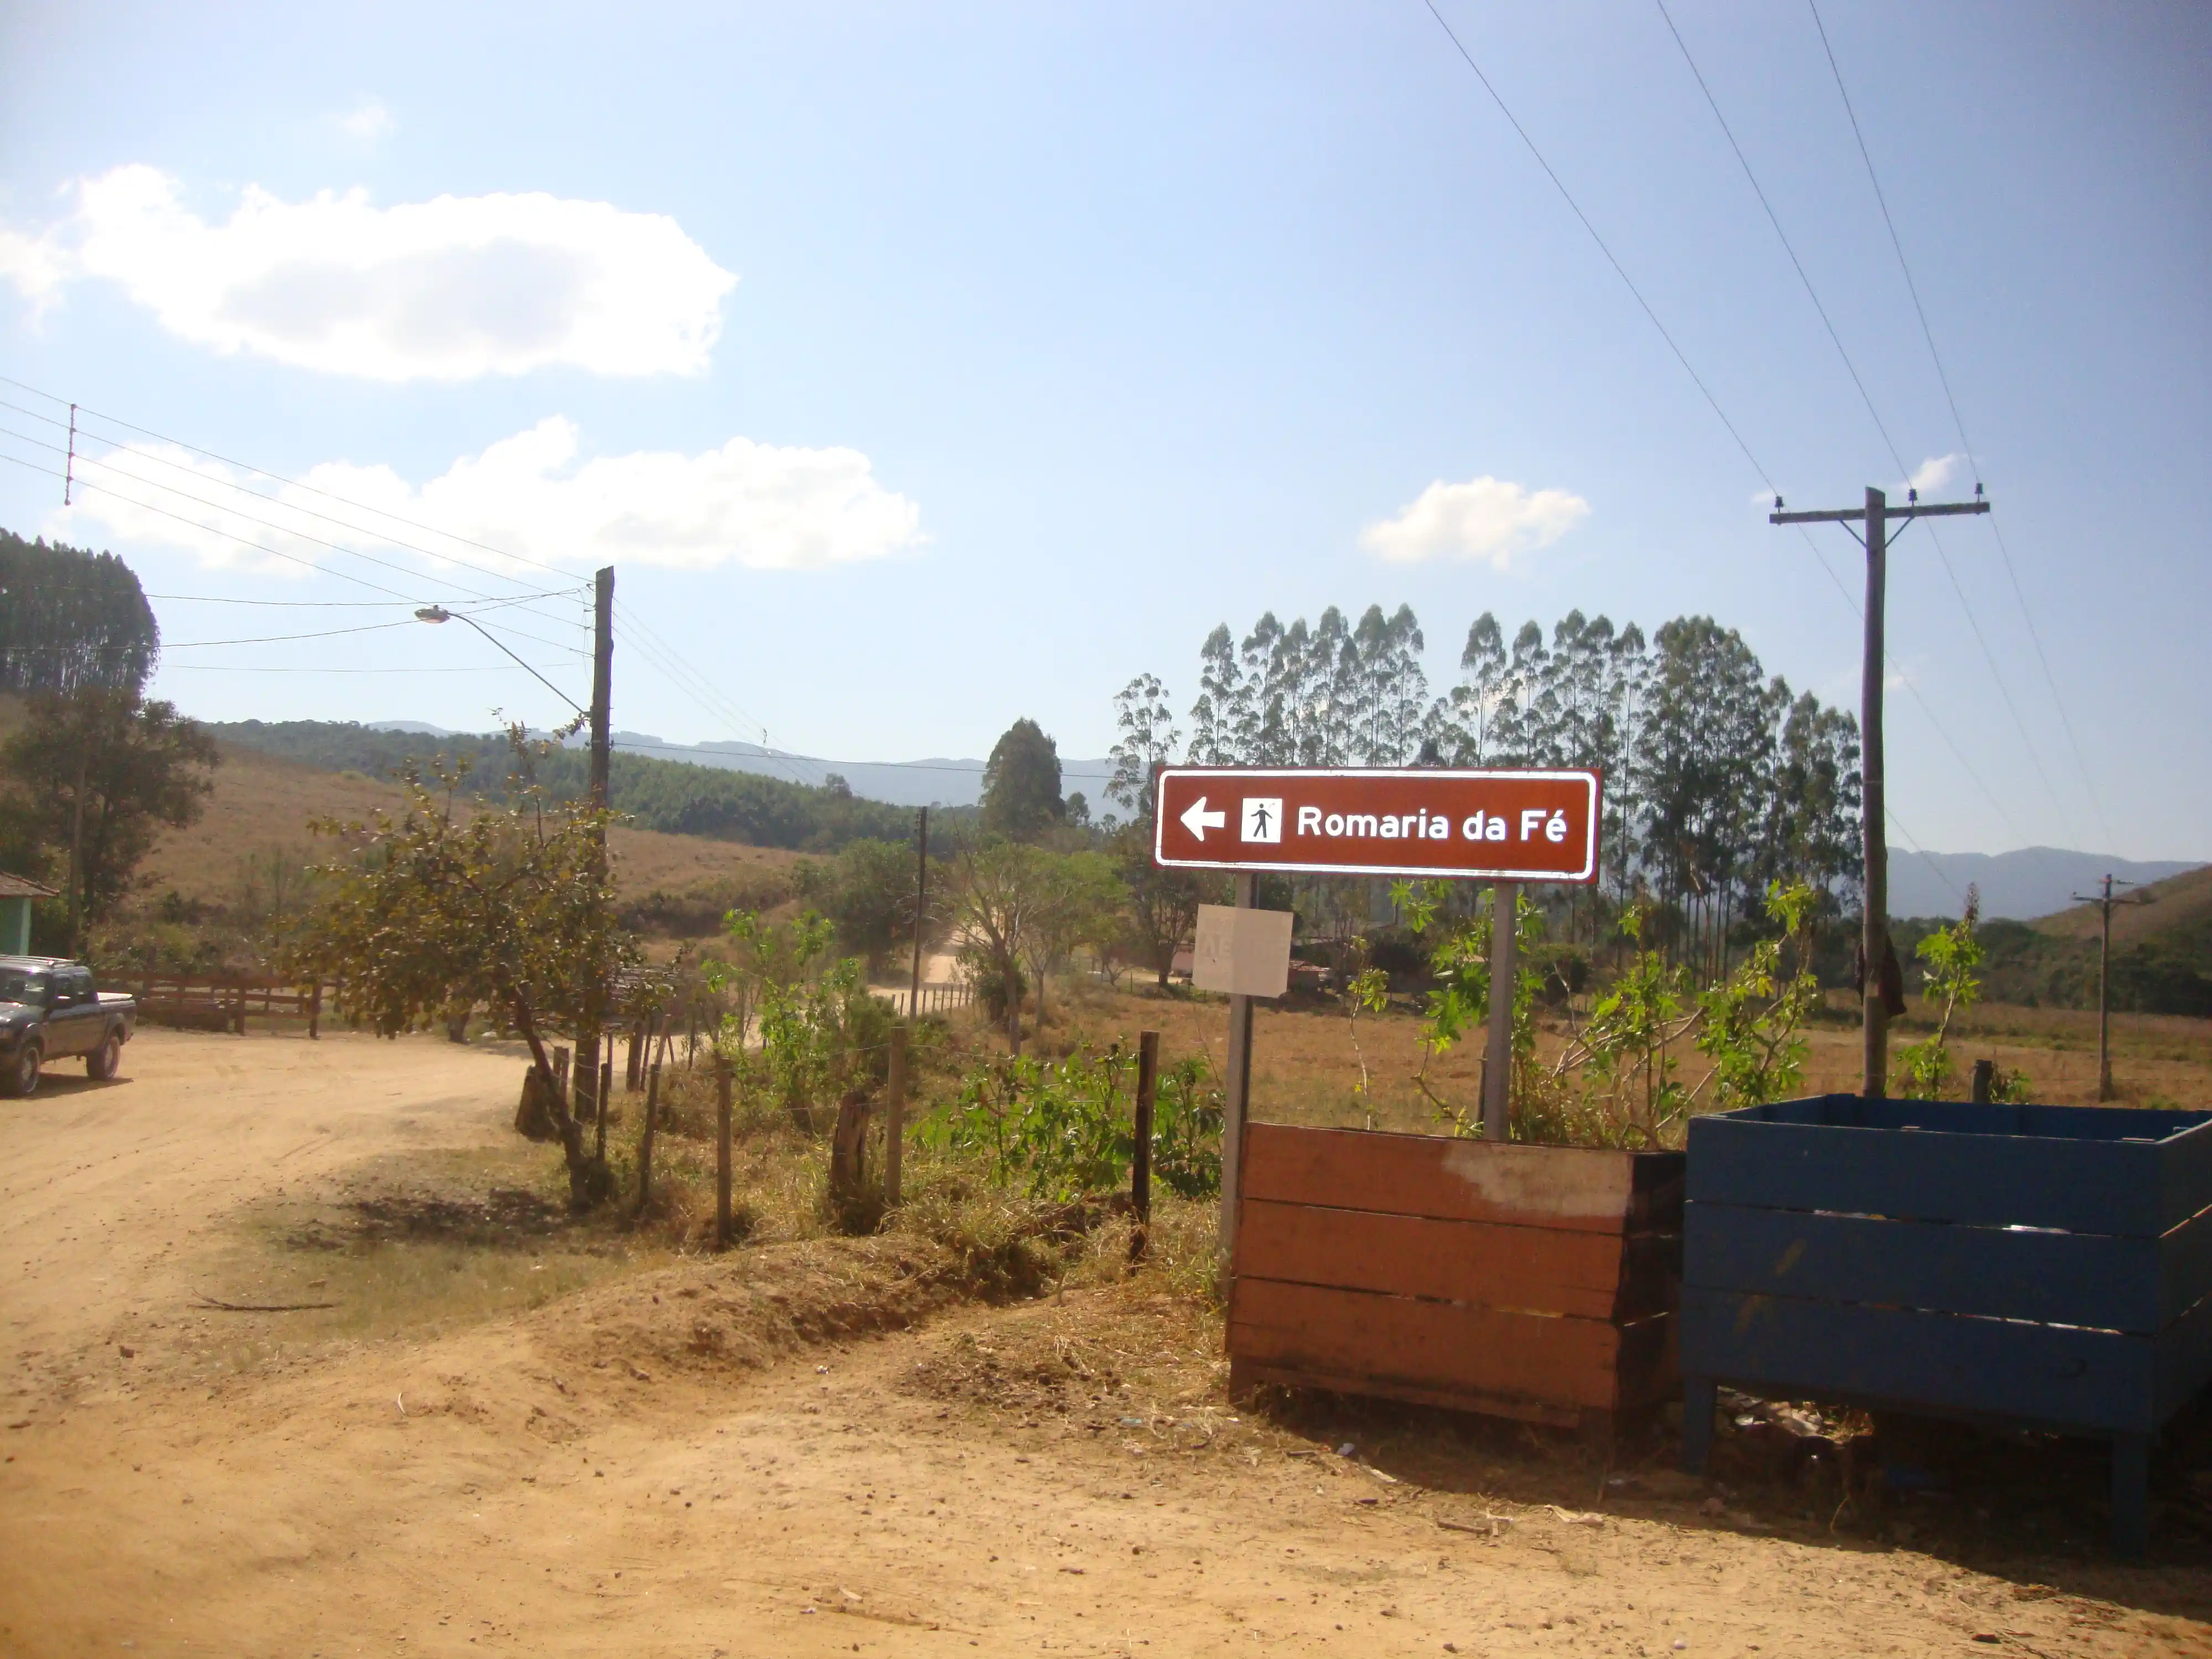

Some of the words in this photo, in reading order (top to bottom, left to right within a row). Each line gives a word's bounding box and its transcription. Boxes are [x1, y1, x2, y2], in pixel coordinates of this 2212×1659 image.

[1297, 806, 1450, 839] Romaria
[1462, 809, 1508, 841] da
[1520, 808, 1568, 843] Fé
